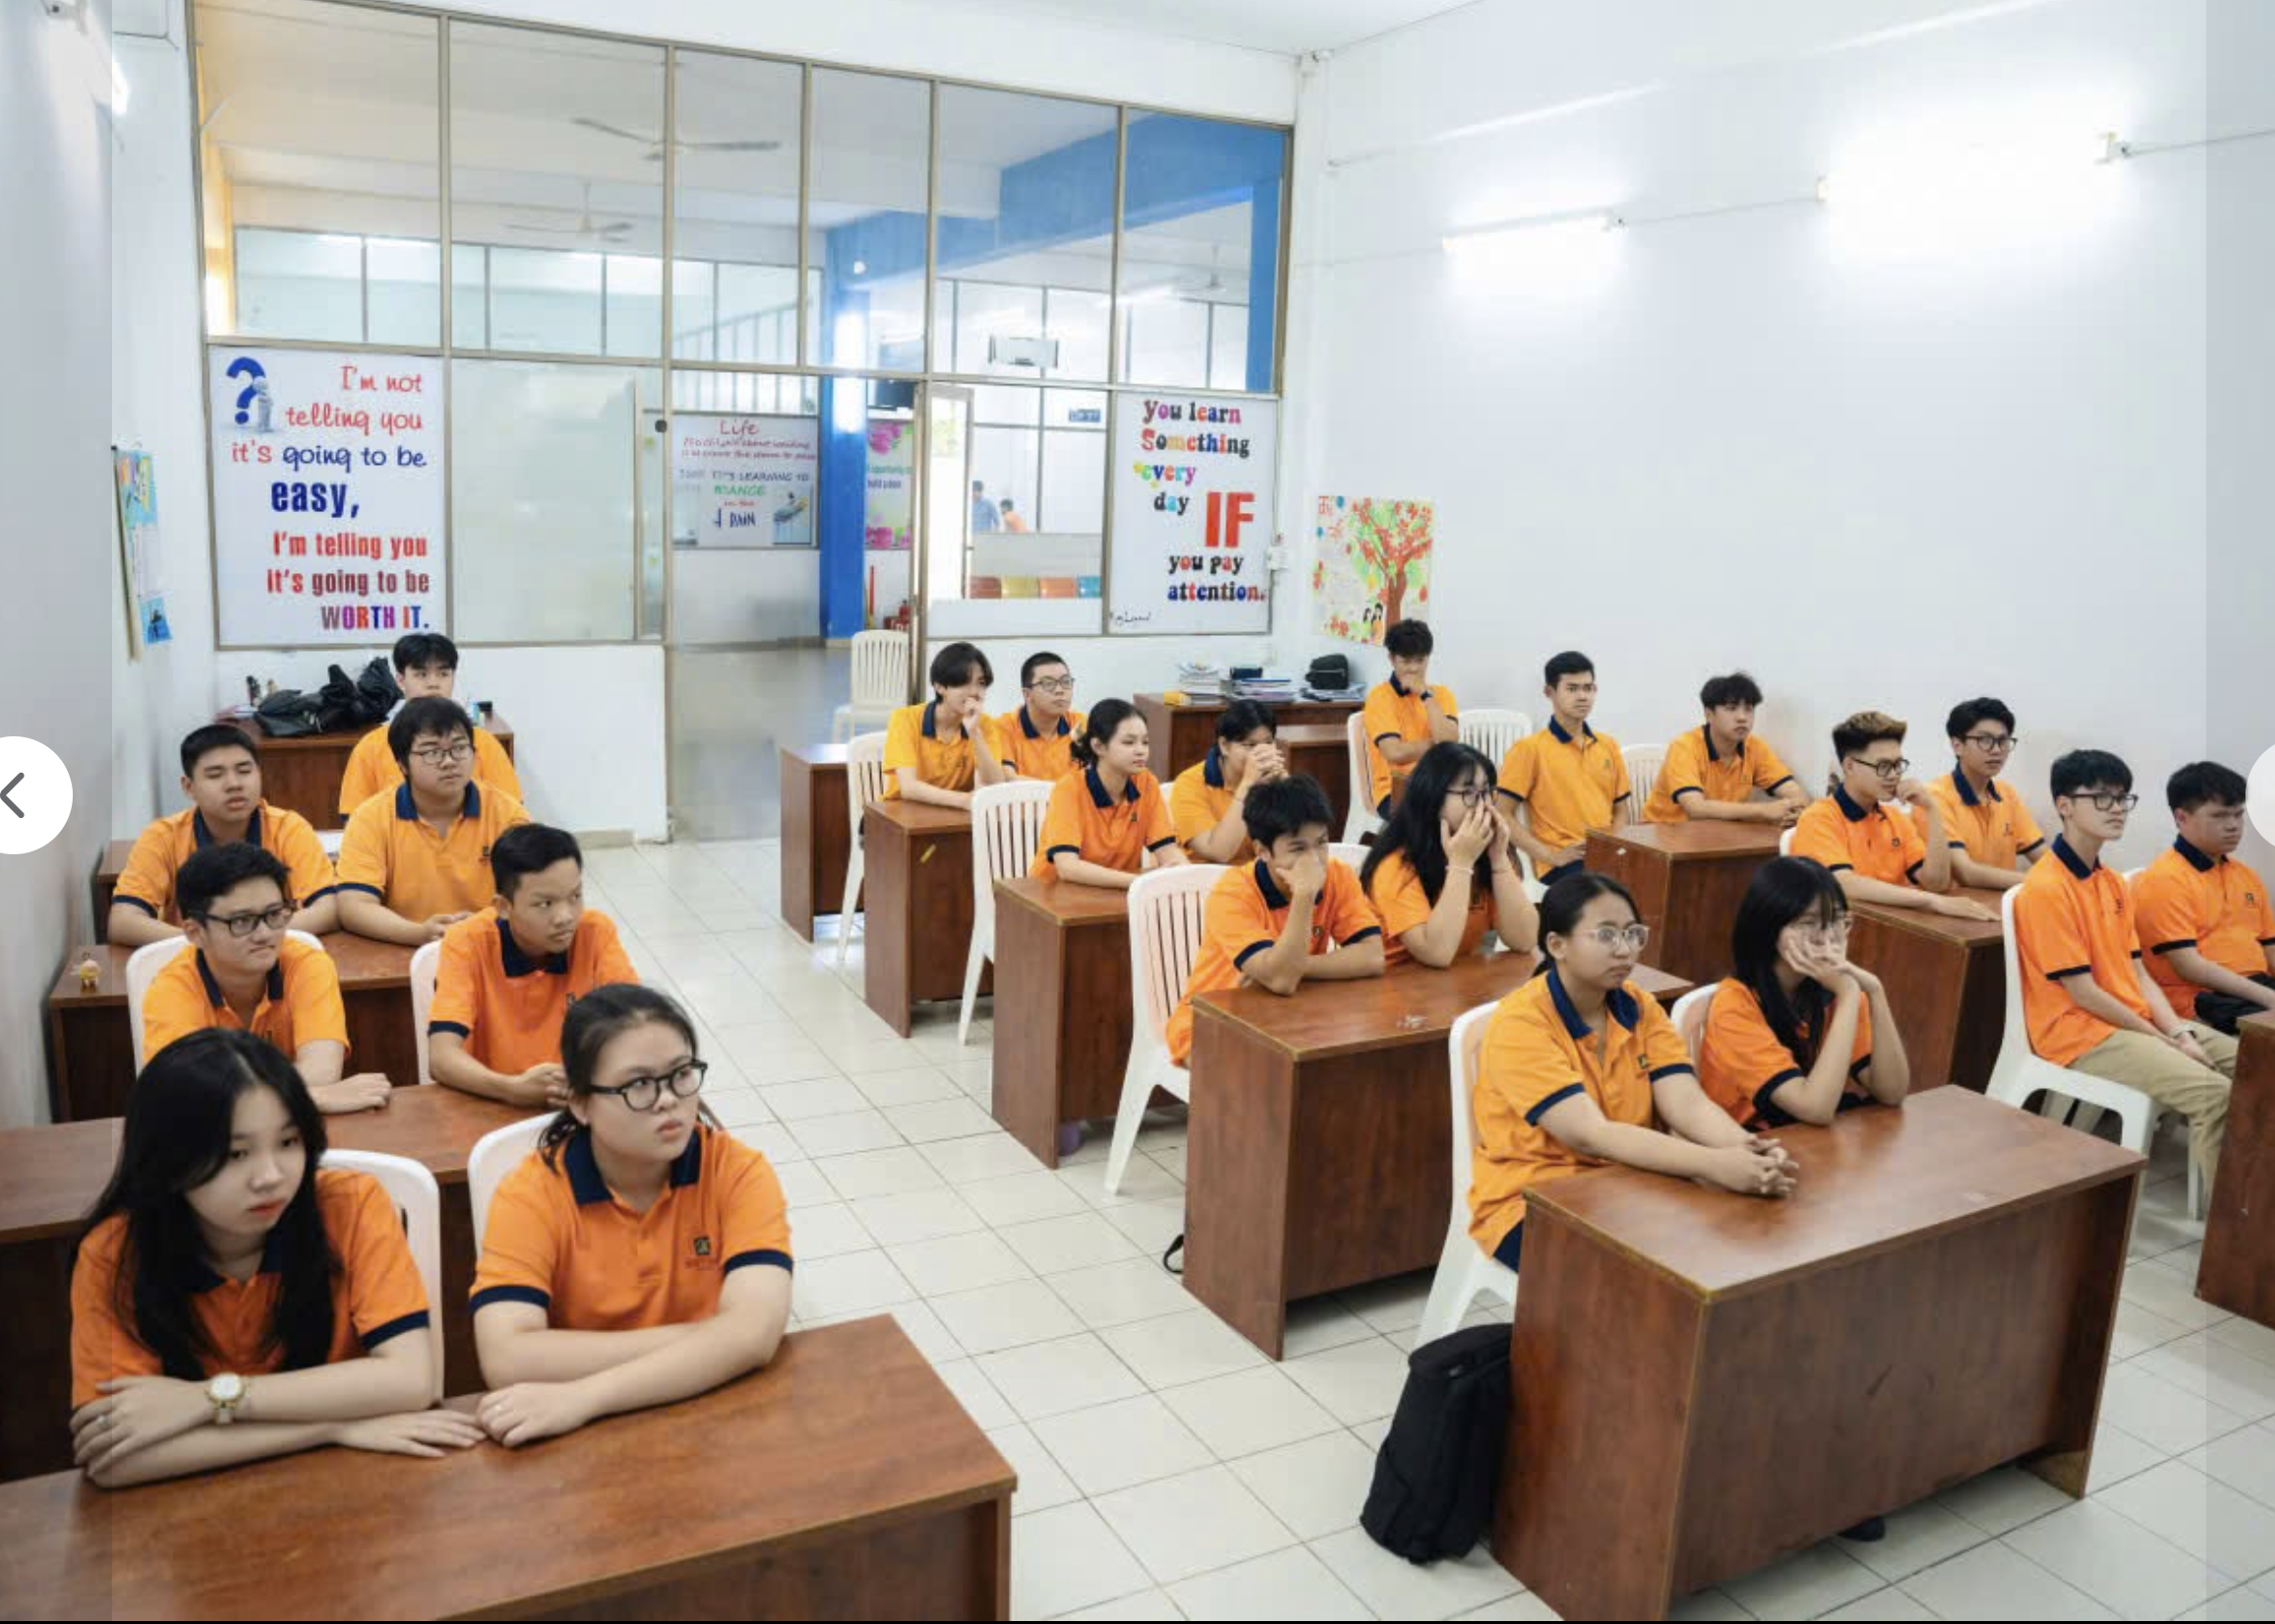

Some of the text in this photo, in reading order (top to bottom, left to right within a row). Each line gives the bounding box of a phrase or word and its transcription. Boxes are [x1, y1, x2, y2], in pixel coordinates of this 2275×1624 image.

[340, 366, 422, 392] I'm not
[286, 402, 423, 436] telling you
[1189, 401, 1242, 423] learn
[720, 419, 759, 439] Life
[232, 439, 427, 474] it's going to be
[1140, 428, 1250, 459] Something
[1141, 464, 1196, 487] every
[271, 482, 360, 519] easy,
[1153, 492, 1190, 516] day
[1205, 491, 1255, 549] IF
[273, 530, 427, 560] I'm telling you
[1168, 555, 1244, 575] you pay
[312, 569, 369, 598] going
[378, 570, 397, 594] to
[405, 569, 430, 594] be
[1167, 581, 1266, 602] attention.
[321, 606, 430, 630] WORTH IT.
